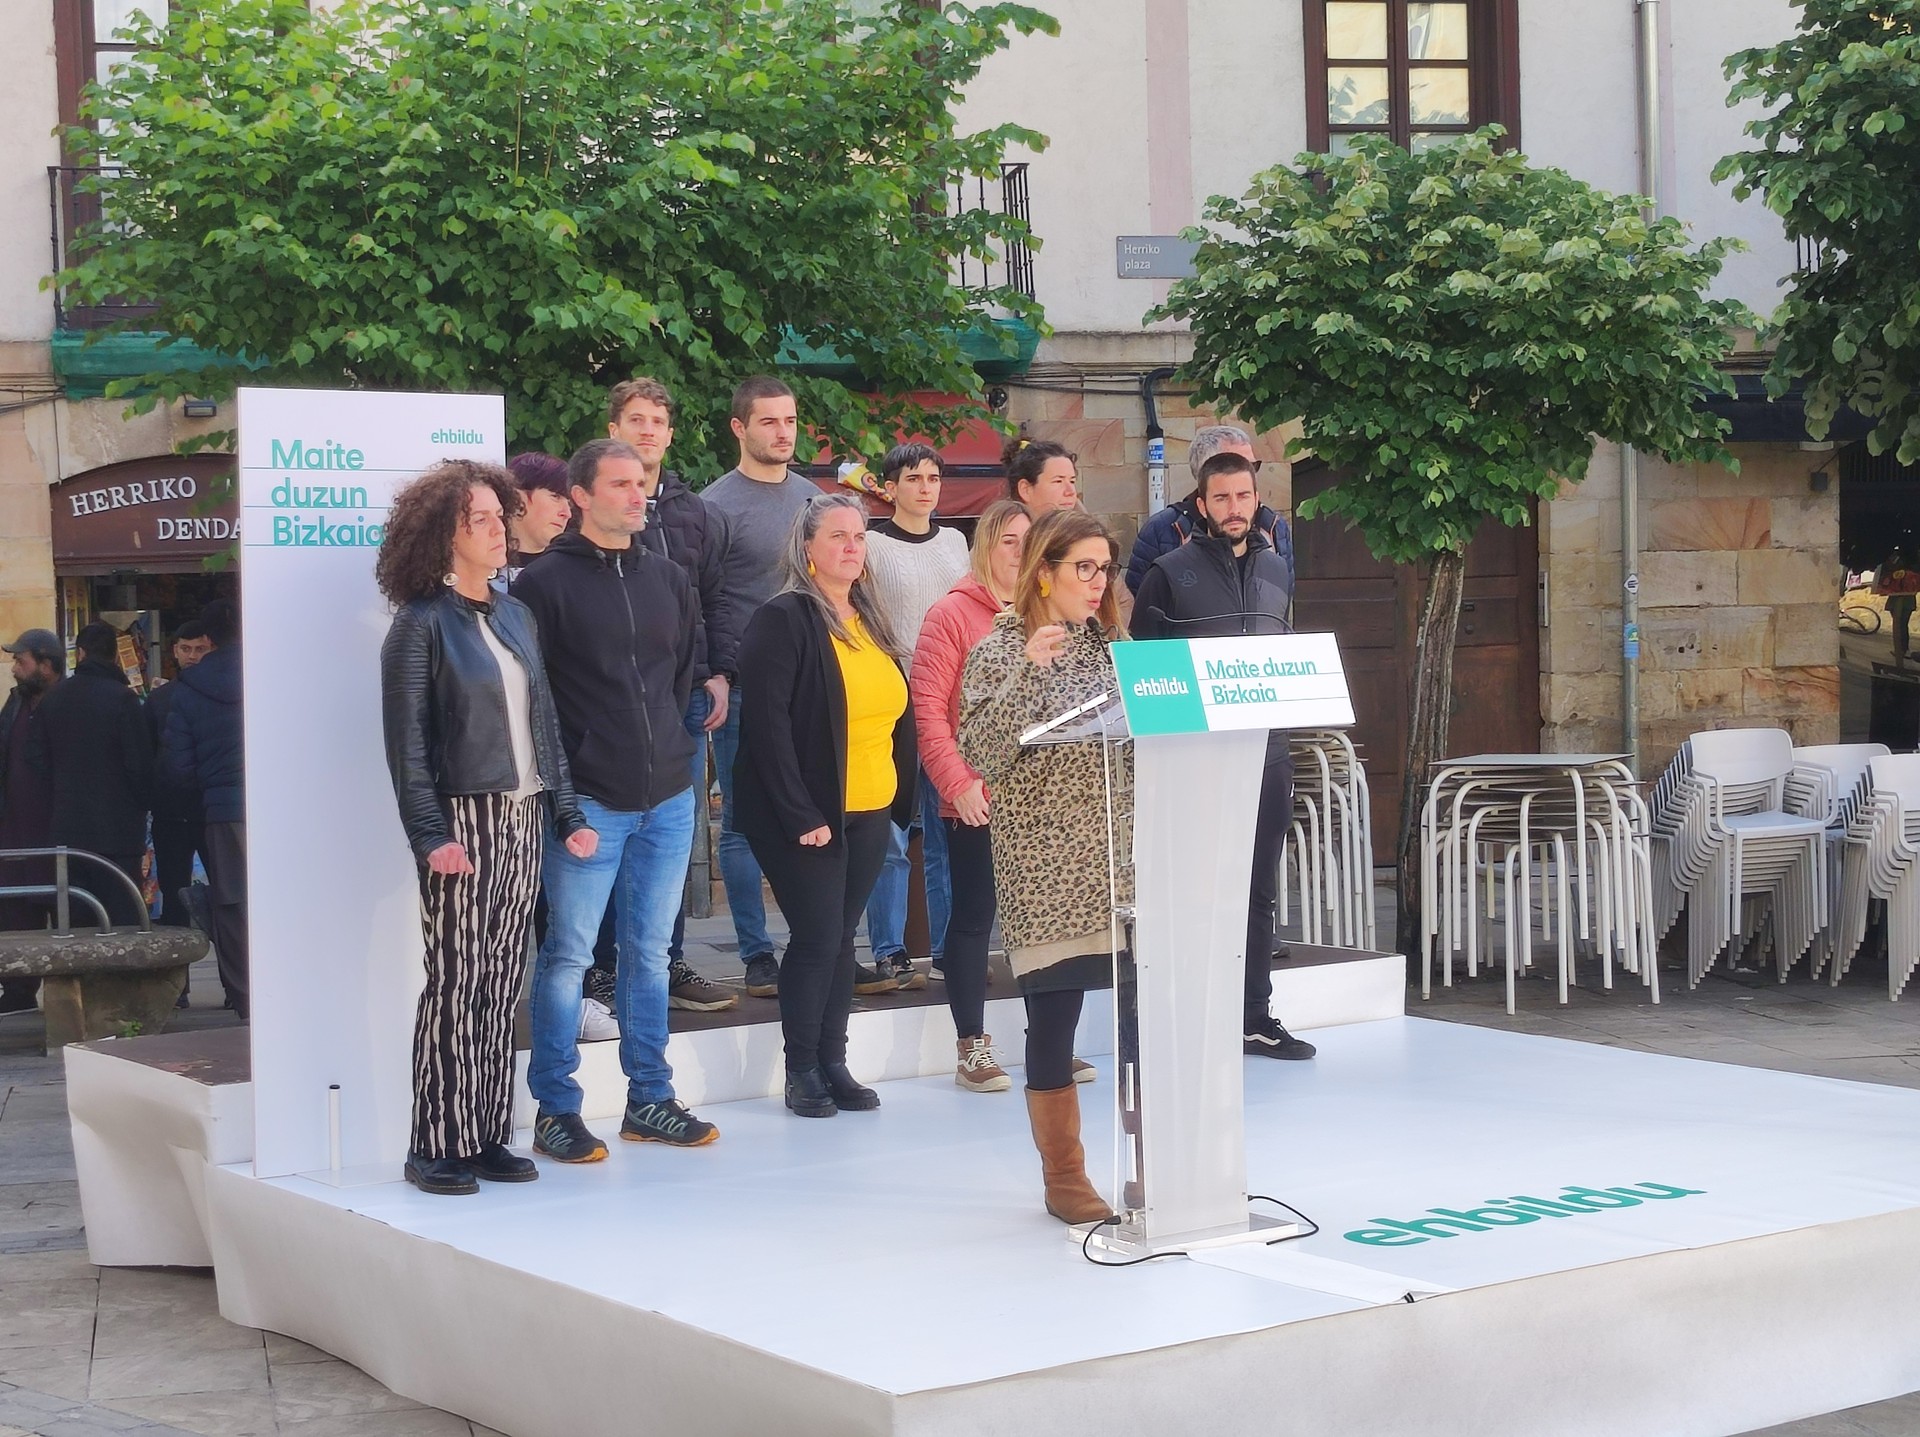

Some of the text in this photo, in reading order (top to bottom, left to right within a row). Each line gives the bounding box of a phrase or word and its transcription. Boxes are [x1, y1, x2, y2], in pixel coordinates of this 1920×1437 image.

[1124, 244, 1160, 255] Herriko
[1125, 259, 1151, 271] plaza
[431, 429, 484, 445] ehbildu
[271, 439, 365, 470] Maite
[69, 476, 197, 517] HERRIKO
[271, 477, 368, 508] duzun
[157, 518, 241, 540] DENDA
[273, 515, 384, 546] Bizkaia
[1206, 656, 1317, 680] Maite duzun
[1133, 676, 1189, 697] ehbildu
[1212, 682, 1278, 705] Bizkaia
[1343, 1181, 1707, 1247] ehbildu
